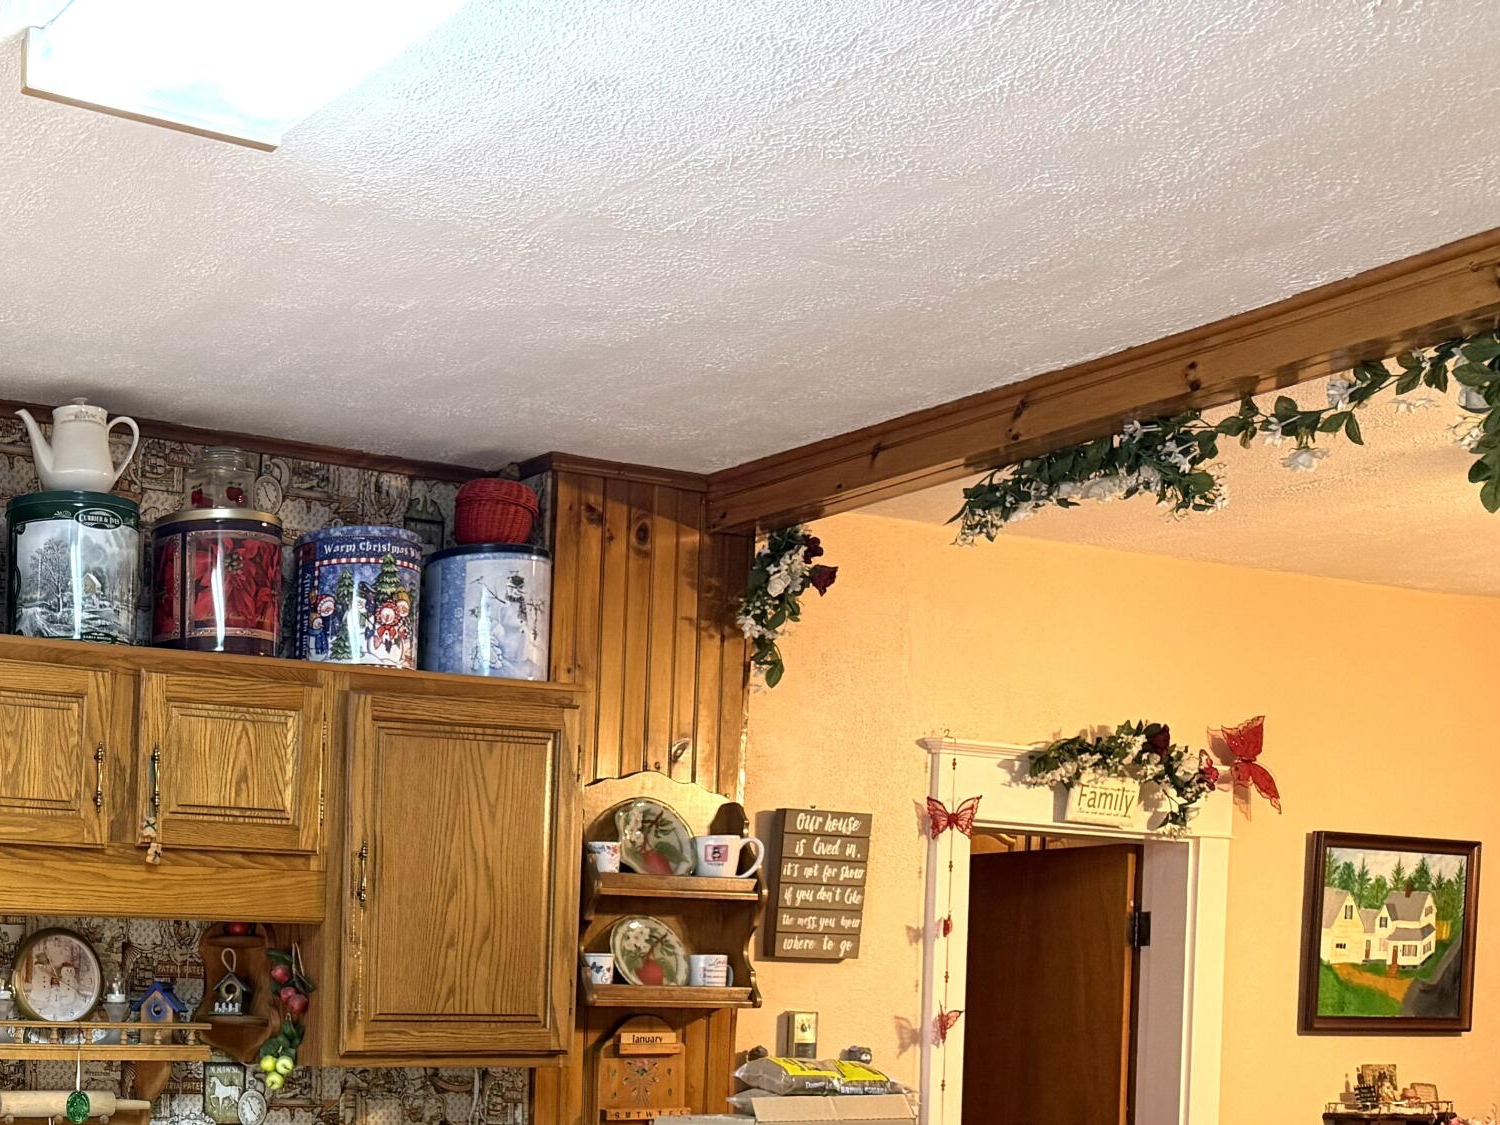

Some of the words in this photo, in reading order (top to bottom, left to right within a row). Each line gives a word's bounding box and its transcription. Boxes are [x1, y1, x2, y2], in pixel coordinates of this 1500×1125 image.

[324, 543, 356, 555] Warm
[360, 541, 408, 555] Christmas
[1078, 784, 1135, 817] Family
[796, 813, 823, 833] Our
[825, 813, 862, 835] house
[795, 838, 806, 857] is
[813, 837, 841, 856] lived
[783, 862, 799, 878] it's
[804, 864, 819, 879] not
[822, 865, 837, 883] for
[839, 865, 866, 881] show
[784, 886, 794, 906] if
[795, 888, 814, 906] you
[817, 886, 842, 903] don't
[844, 888, 863, 905] like
[782, 914, 795, 926] the
[819, 917, 836, 932] you
[840, 916, 861, 929] know
[783, 935, 815, 950] where
[822, 935, 834, 951] to
[839, 940, 853, 958] go
